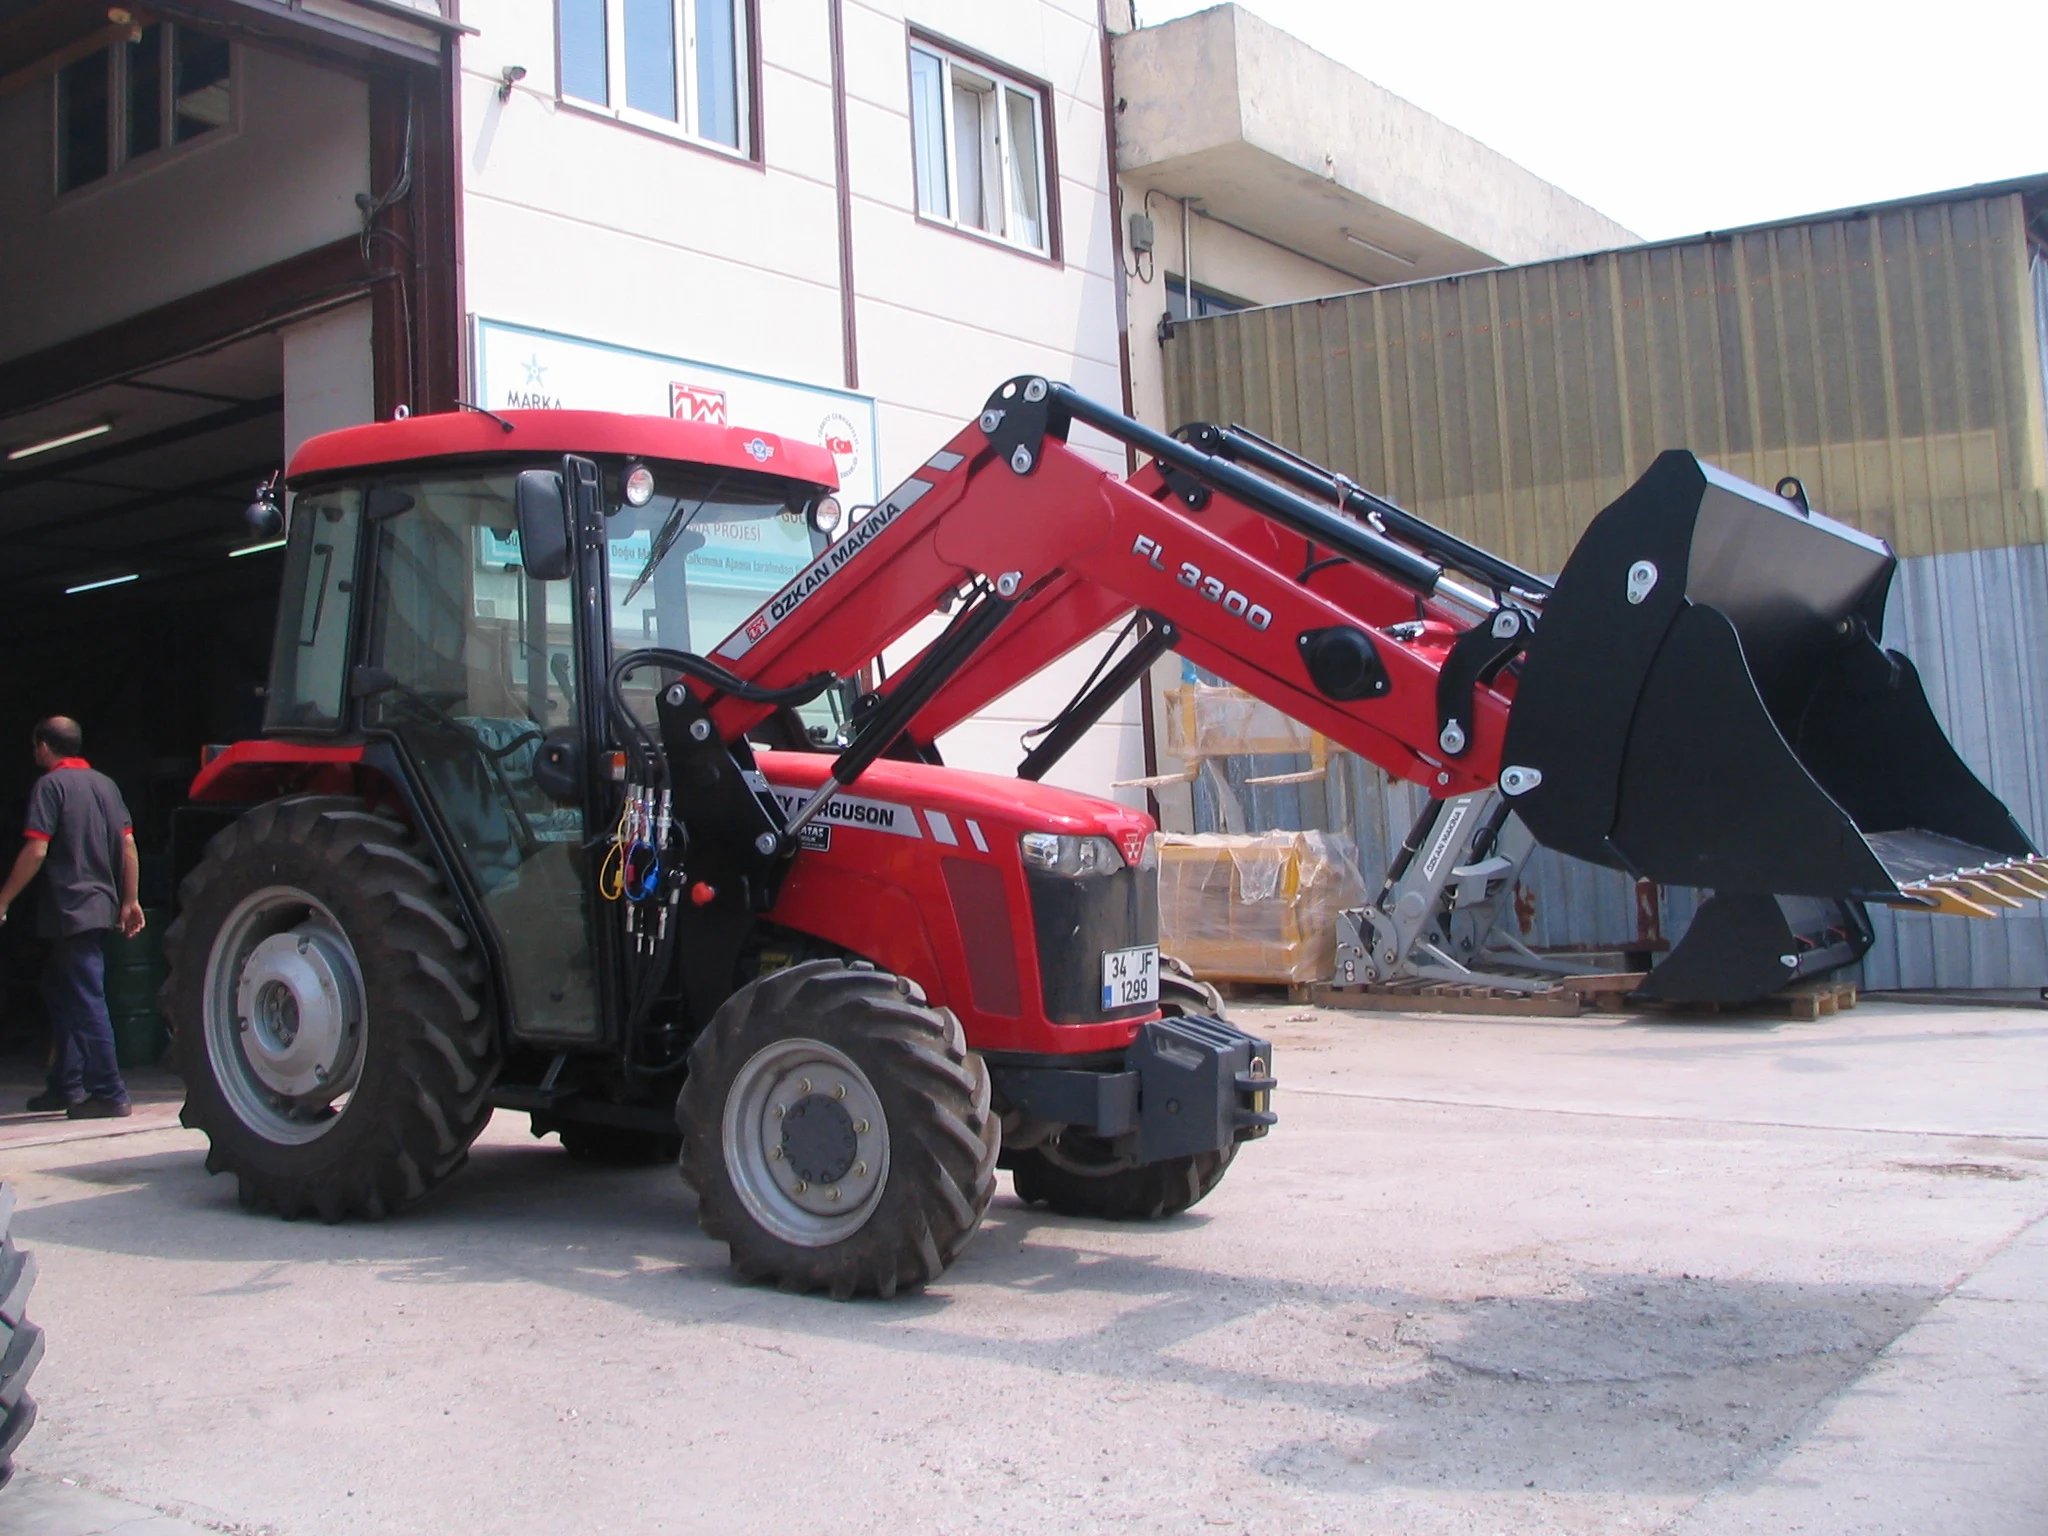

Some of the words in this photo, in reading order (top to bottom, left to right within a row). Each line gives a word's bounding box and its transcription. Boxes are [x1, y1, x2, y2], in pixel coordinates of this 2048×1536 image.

[507, 389, 562, 410] MARKA
[714, 523, 760, 542] PROJESİ
[771, 562, 830, 621] ÖZKAN
[830, 503, 901, 568] MAKİNA
[1131, 534, 1165, 571] FL
[1177, 562, 1273, 632] 3300
[1112, 955, 1127, 979] 34
[1138, 951, 1153, 975] JF
[1121, 977, 1148, 1004] 1299
